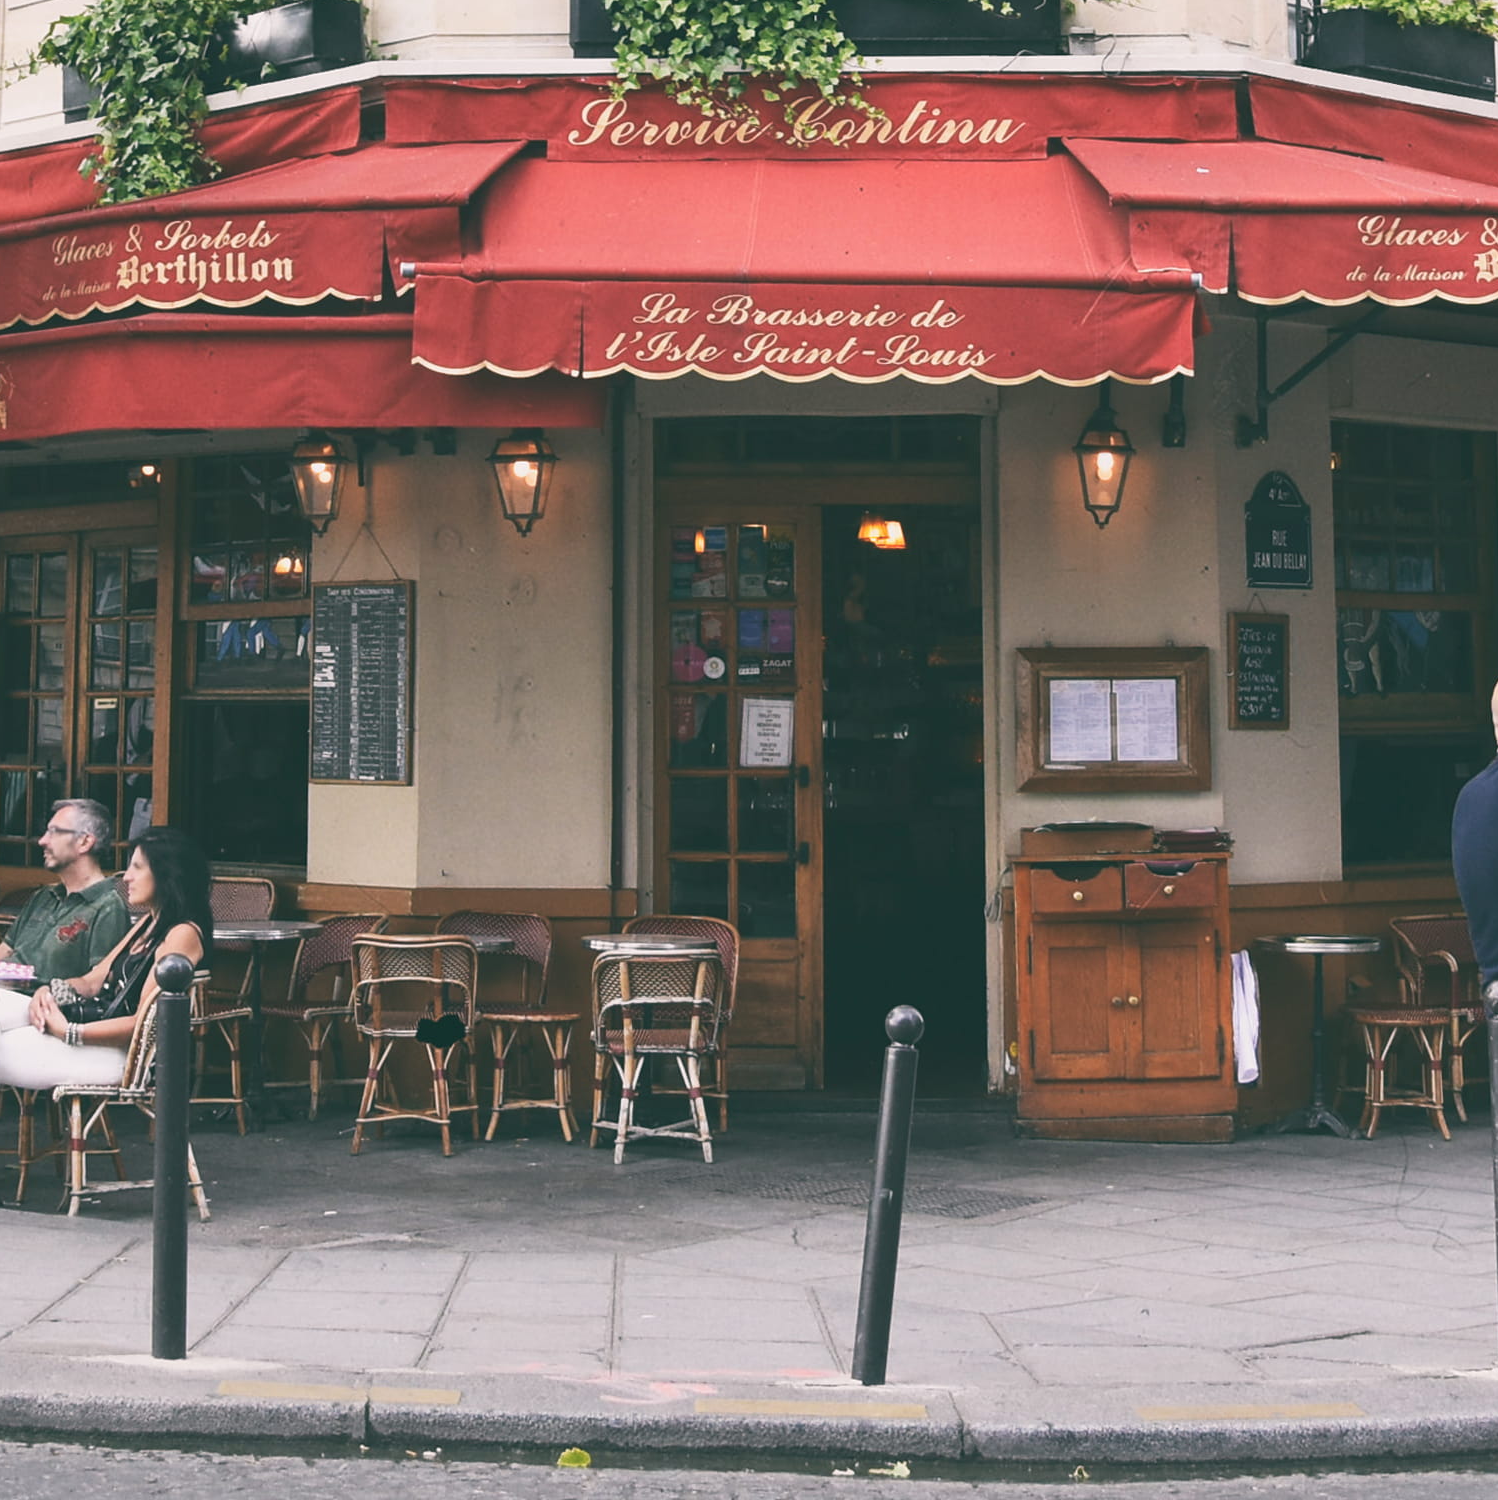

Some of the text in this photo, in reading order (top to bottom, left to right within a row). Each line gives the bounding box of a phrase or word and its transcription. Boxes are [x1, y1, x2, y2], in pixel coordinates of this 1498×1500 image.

[567, 95, 1027, 148] Service Continu
[51, 220, 280, 266] Glaces & Sorbets
[1356, 214, 1469, 246] Glaces
[41, 284, 57, 301] de
[72, 280, 112, 298] Maison
[116, 251, 294, 291] Berthillon
[1345, 265, 1368, 282] de
[1373, 265, 1394, 282] la
[1395, 264, 1468, 282] Maison
[631, 293, 966, 328] La Brasserie de
[605, 331, 726, 363] l'Isle
[1271, 529, 1288, 547] RUE
[1252, 551, 1307, 570] JEAN DU BELLAY
[762, 659, 793, 668] ZAGAT
